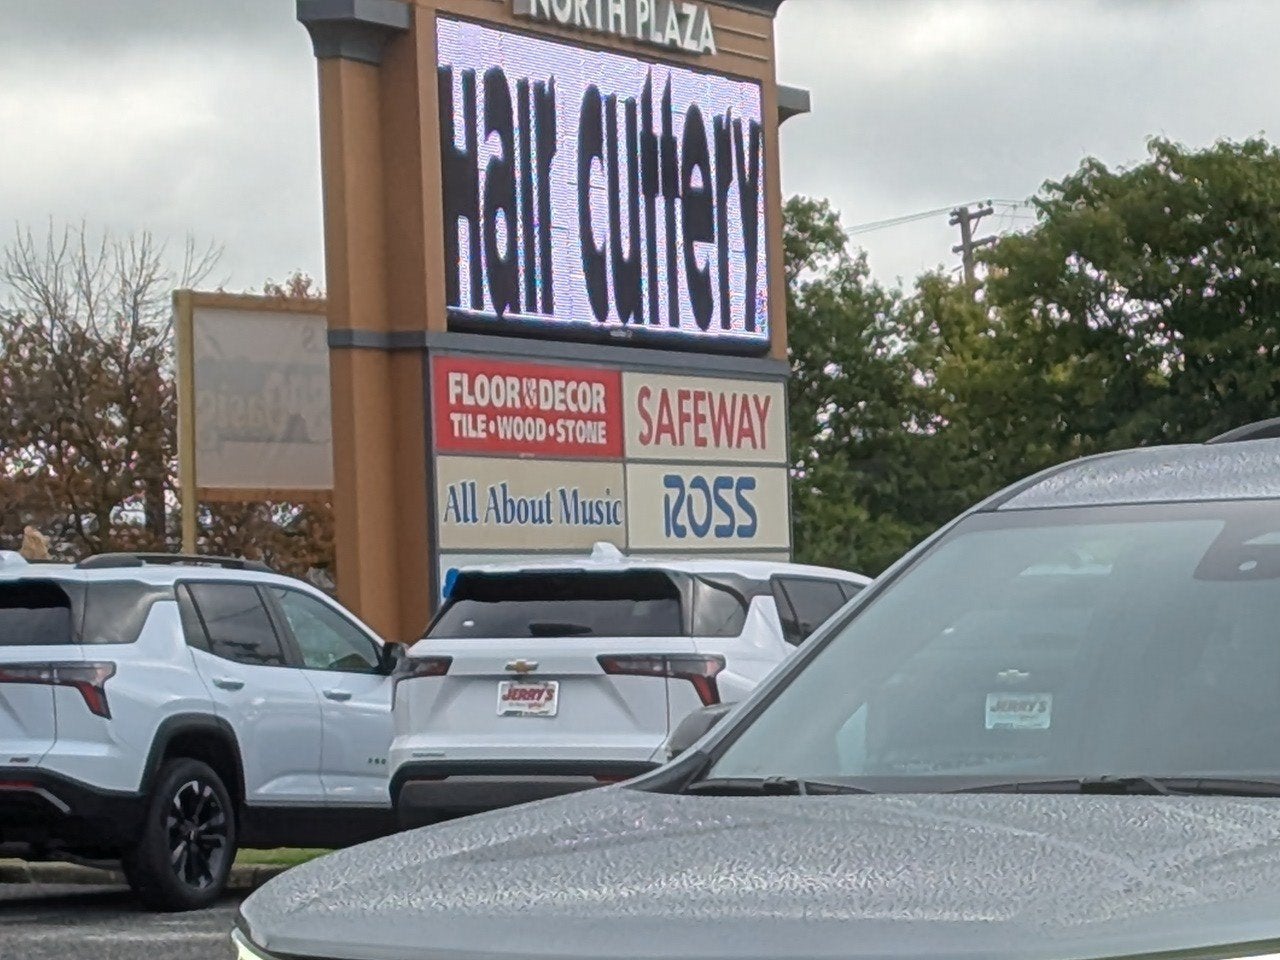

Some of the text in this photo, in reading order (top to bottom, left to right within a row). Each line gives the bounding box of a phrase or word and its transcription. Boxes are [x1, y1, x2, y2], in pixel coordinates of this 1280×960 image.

[636, 0, 717, 55] PLAZA
[448, 372, 521, 409] FLOOR
[539, 378, 606, 414] DECOR
[638, 385, 771, 450] SAFEWAY
[443, 481, 623, 526] All About Music
[663, 474, 757, 539] ROSS
